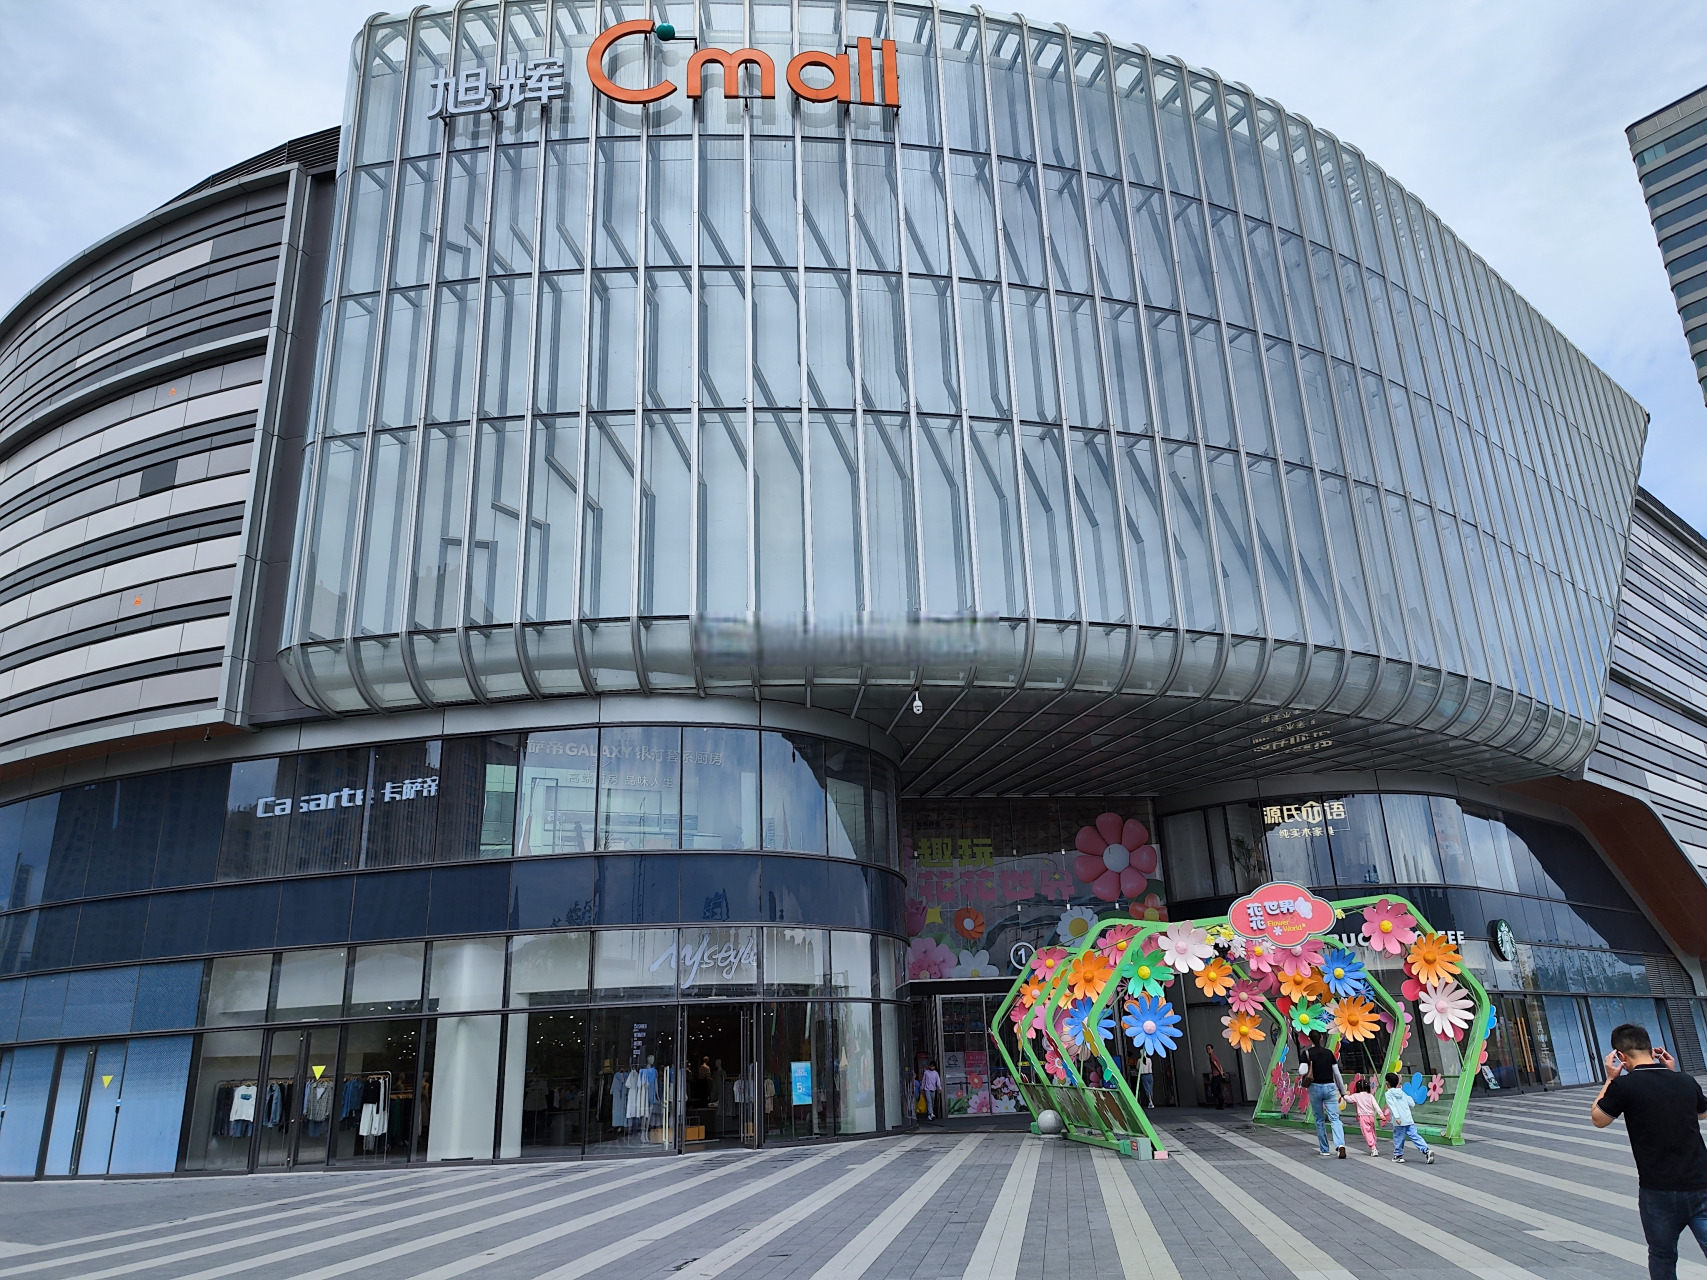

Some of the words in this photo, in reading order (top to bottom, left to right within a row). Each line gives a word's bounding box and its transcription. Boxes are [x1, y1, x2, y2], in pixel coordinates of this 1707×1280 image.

[587, 19, 899, 107] Cmall
[427, 57, 565, 119] 旭辉
[380, 776, 439, 802] 卡萨帝
[918, 838, 994, 867] 趣玩
[918, 870, 1075, 901] 花花世界
[1267, 919, 1289, 927] Flower
[1283, 924, 1303, 932] World
